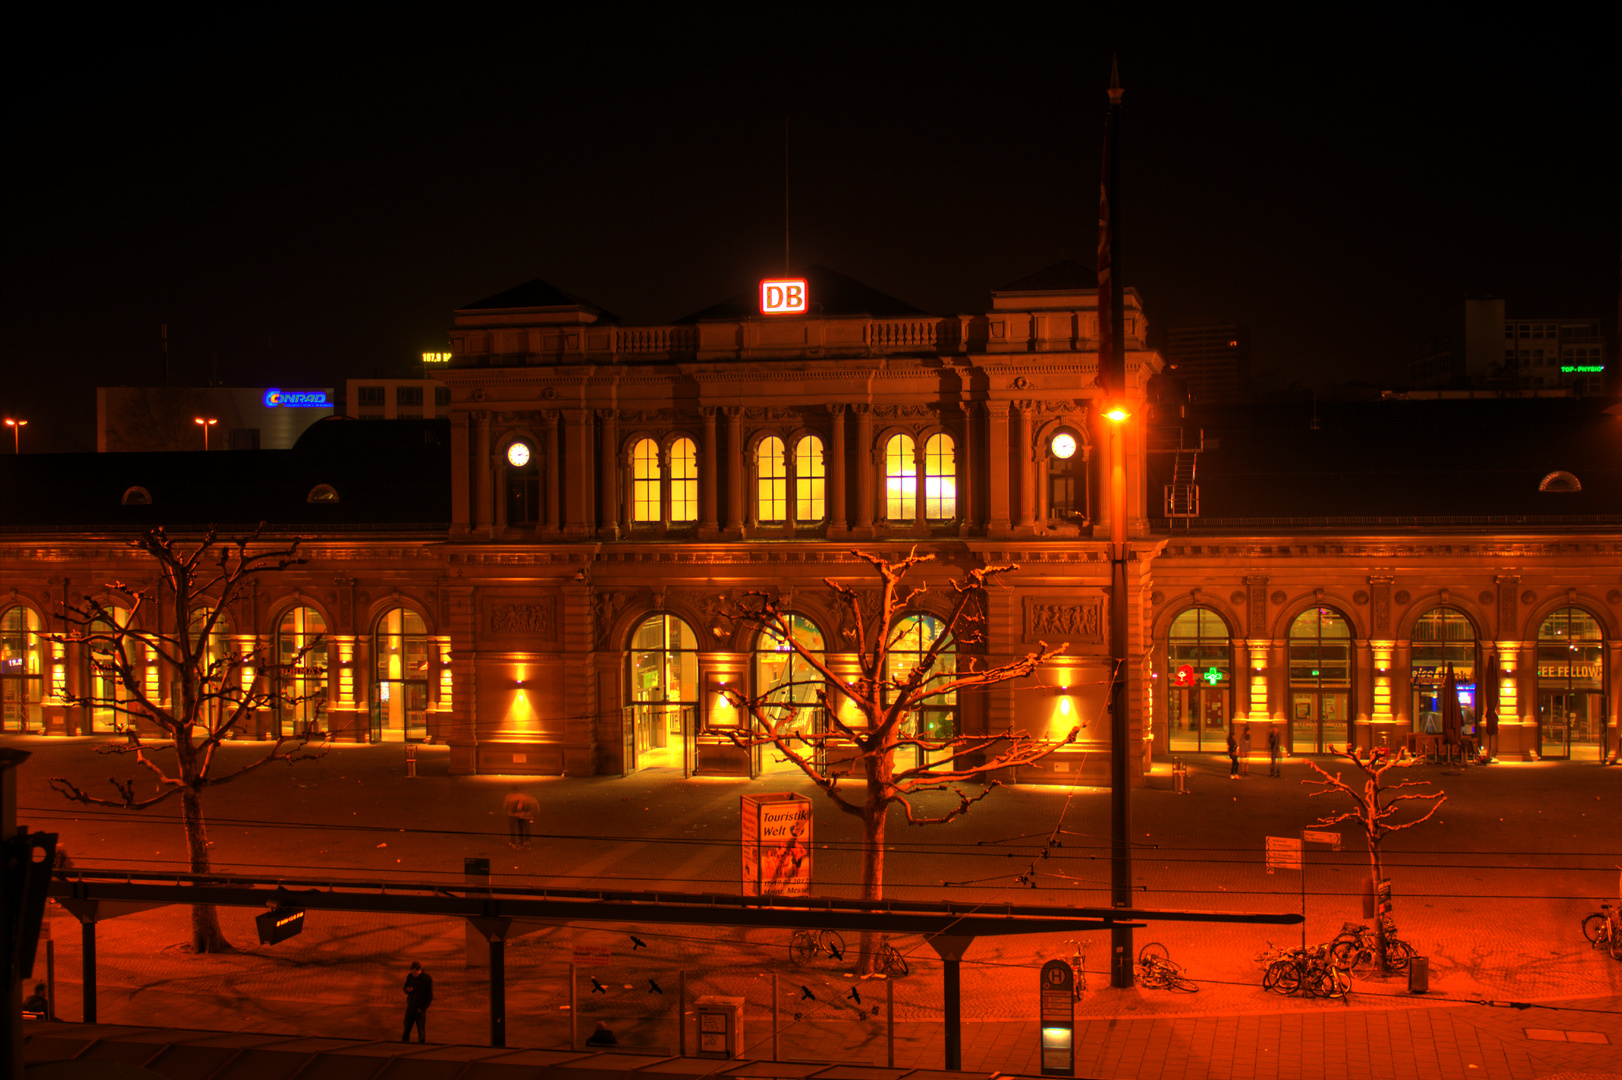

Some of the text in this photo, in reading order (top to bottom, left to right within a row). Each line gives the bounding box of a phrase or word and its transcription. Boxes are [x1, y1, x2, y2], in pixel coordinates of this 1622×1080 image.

[766, 285, 803, 309] DB
[422, 352, 442, 363] 107,9
[264, 391, 327, 408] CONRAD
[763, 809, 808, 822] Touristik
[763, 825, 786, 836] Welt
